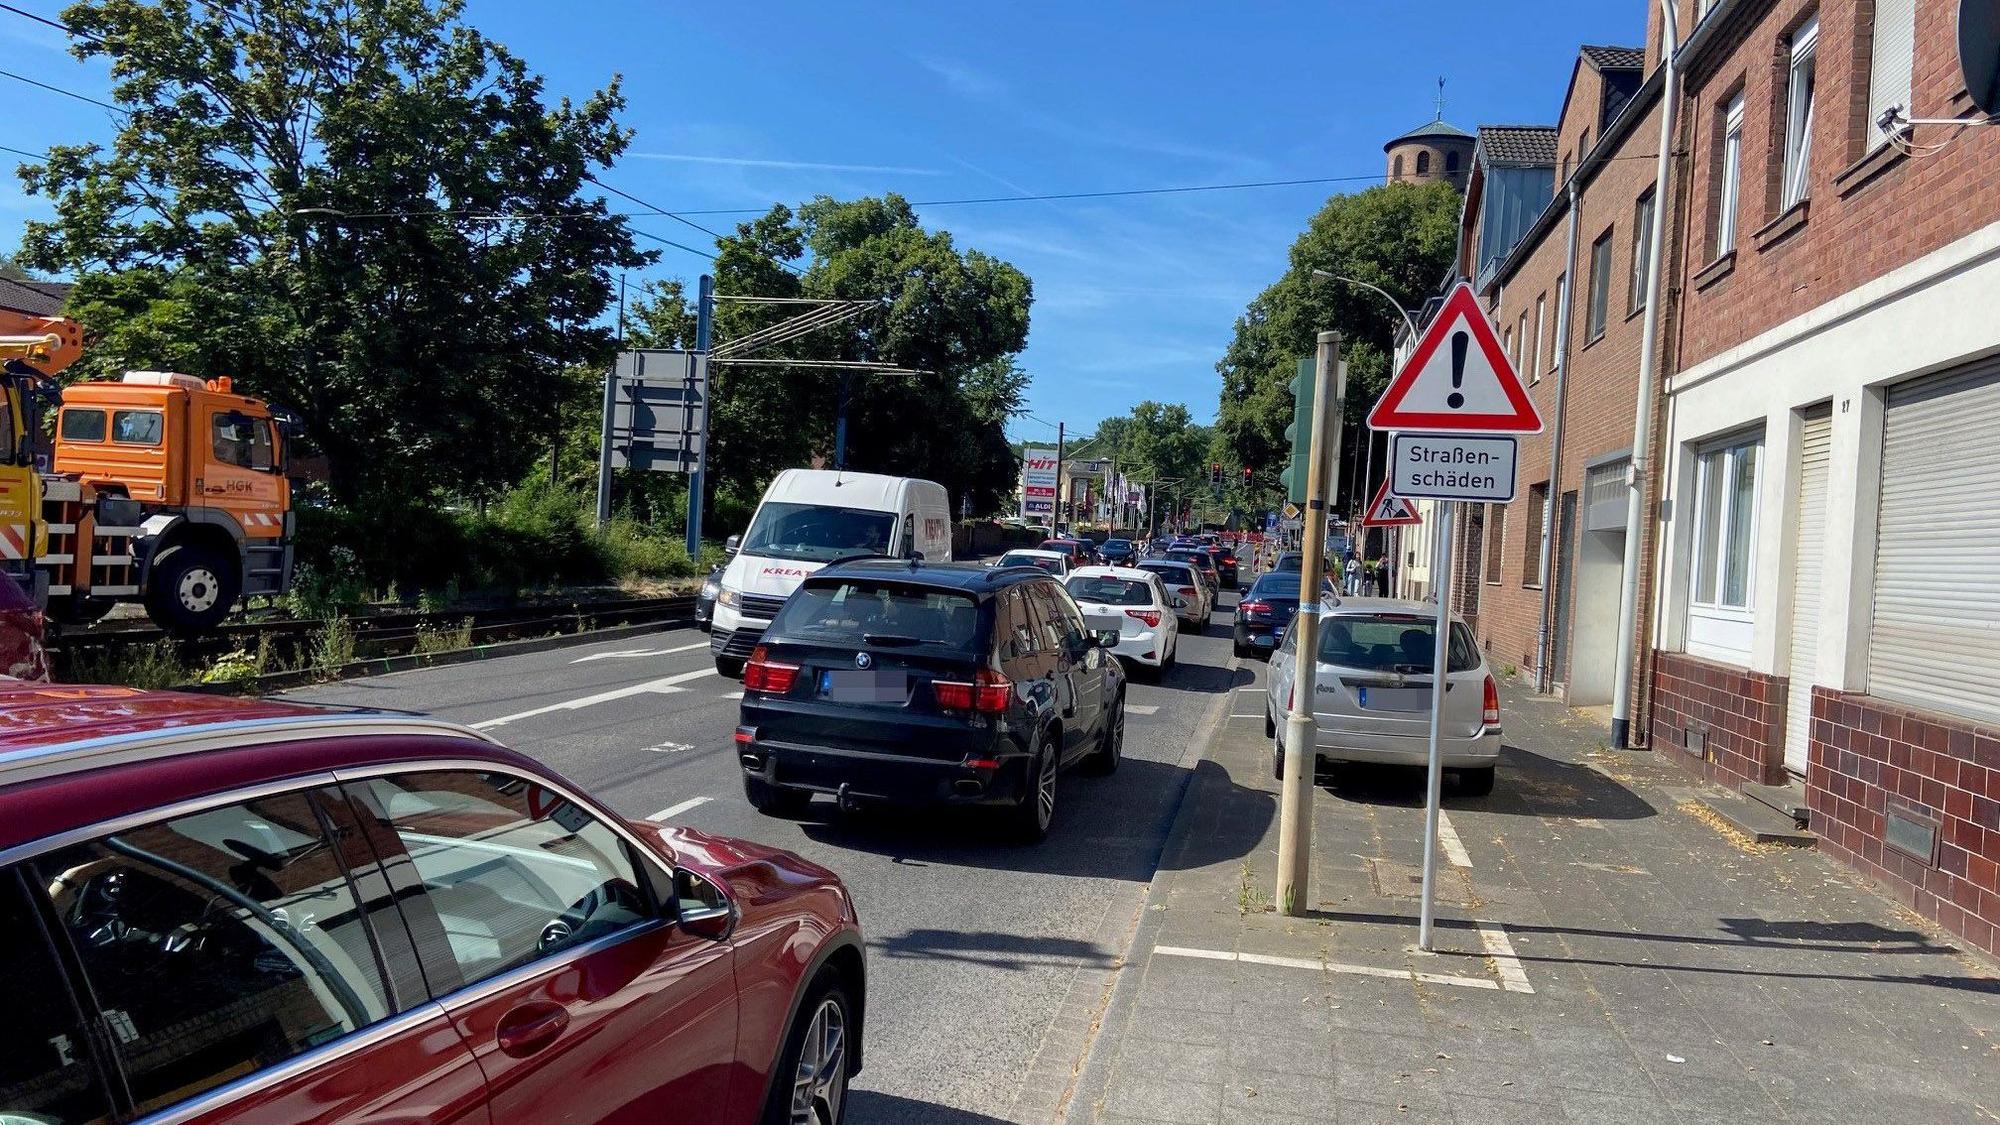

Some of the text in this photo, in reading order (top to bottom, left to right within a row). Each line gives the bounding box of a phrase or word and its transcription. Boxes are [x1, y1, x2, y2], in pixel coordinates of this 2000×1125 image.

[1410, 446, 1500, 465] Straßen-
[226, 480, 253, 492] HGK
[1411, 470, 1495, 489] schäden
[1035, 503, 1051, 511] ALDI
